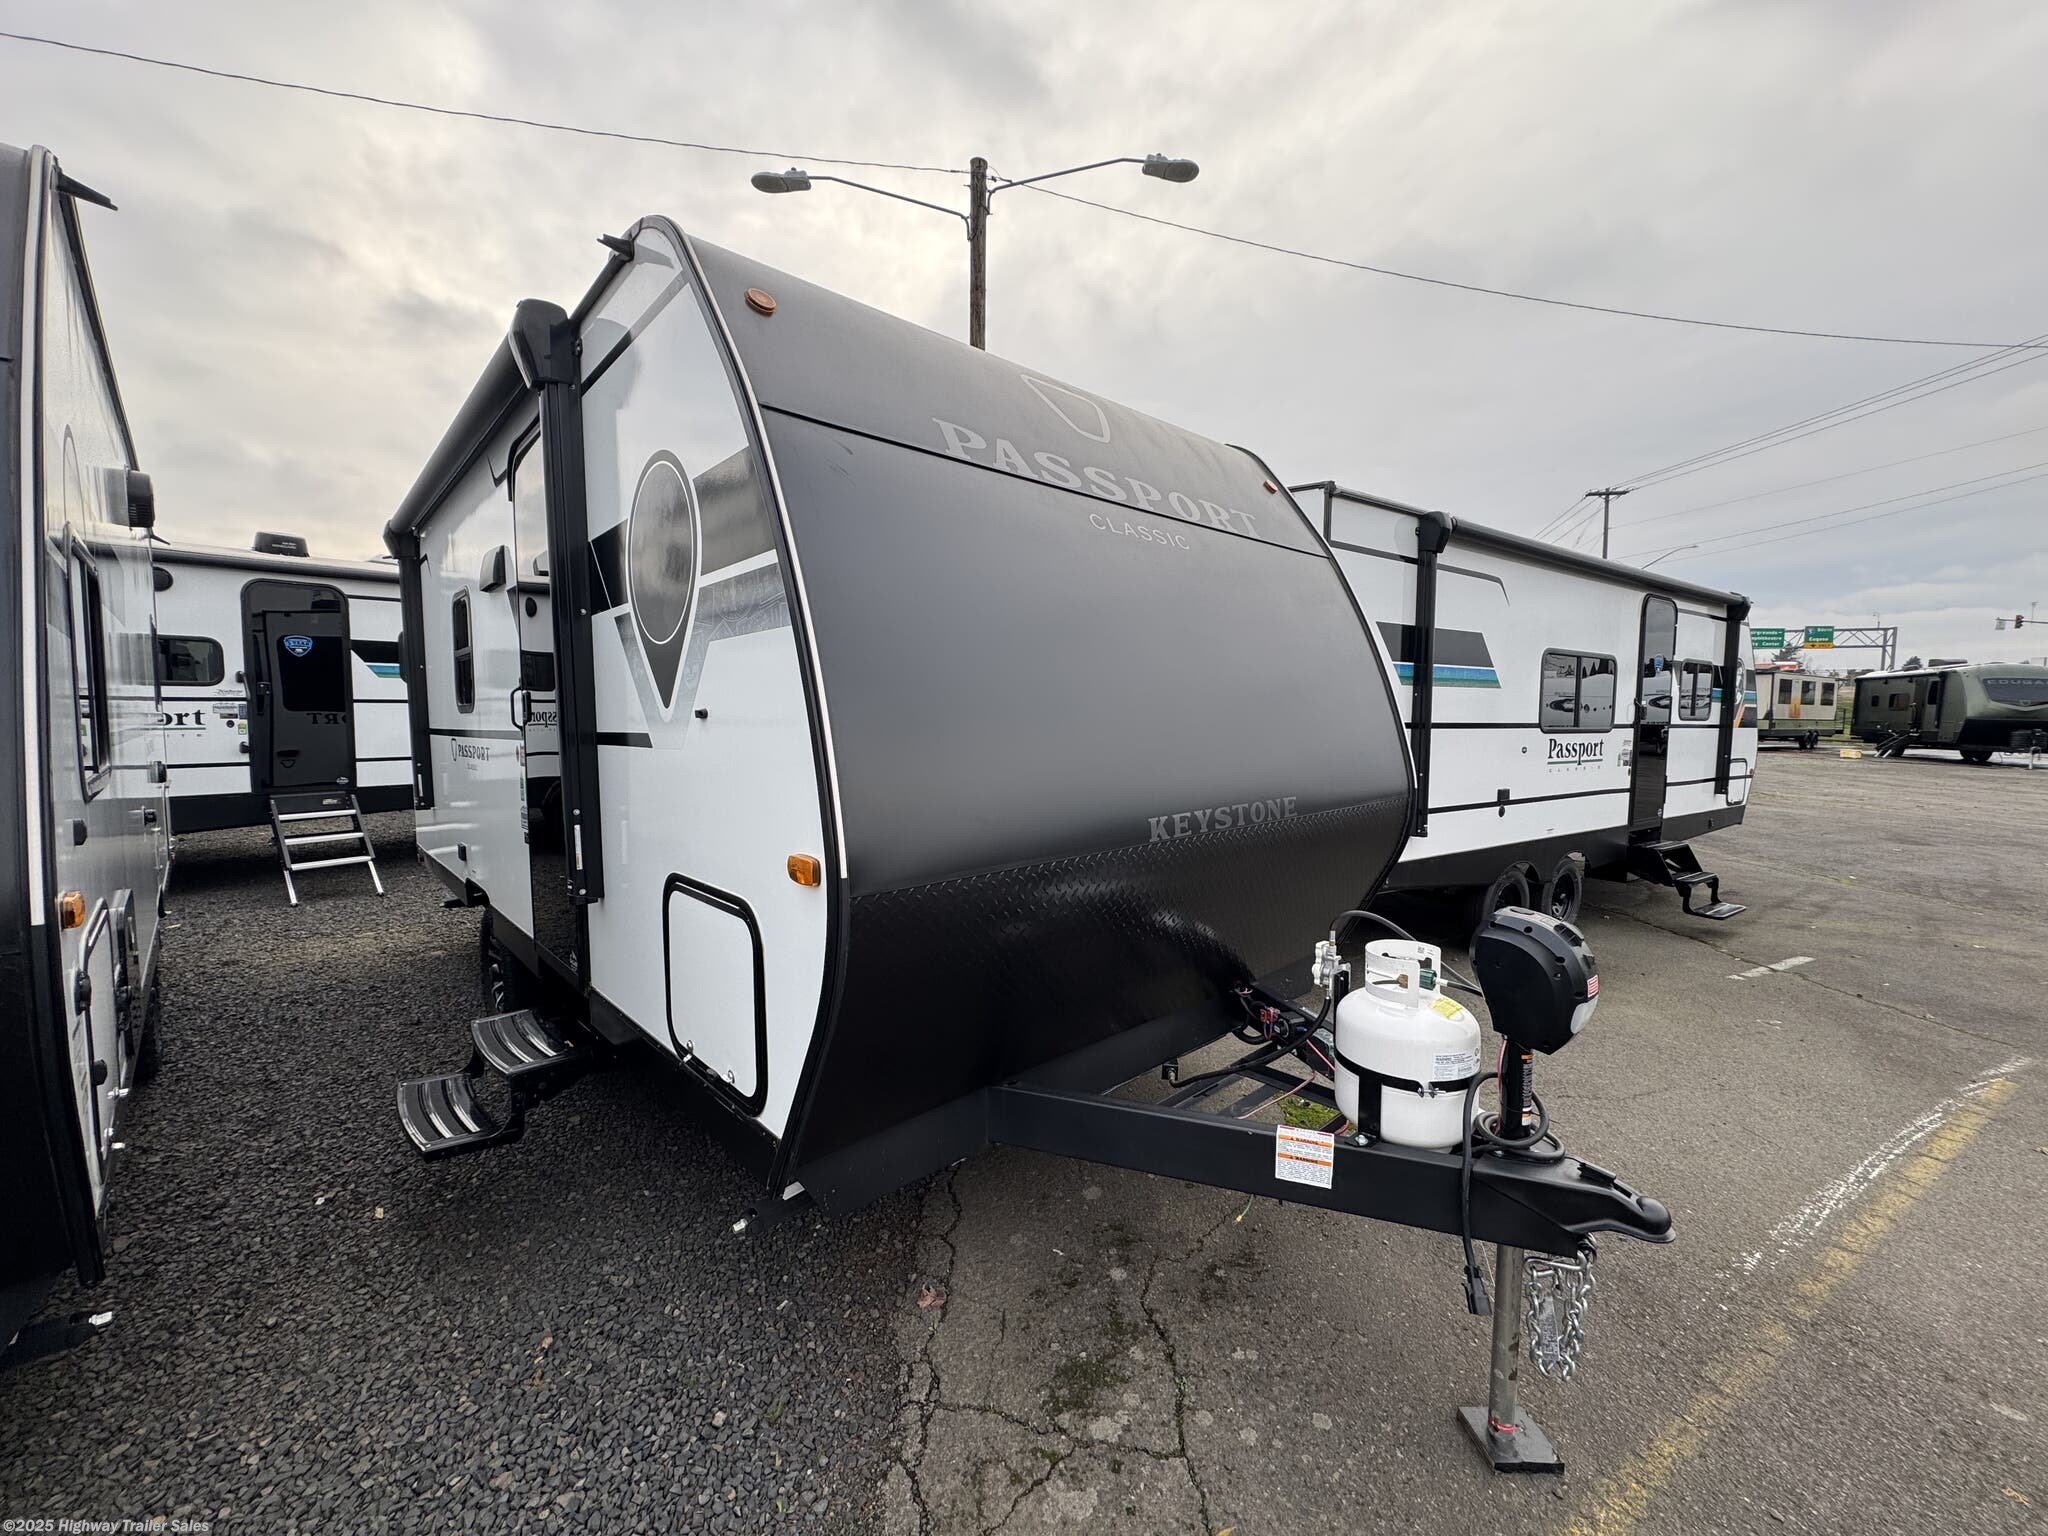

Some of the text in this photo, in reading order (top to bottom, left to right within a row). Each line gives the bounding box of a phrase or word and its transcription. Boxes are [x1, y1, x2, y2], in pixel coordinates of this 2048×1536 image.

[932, 417, 1262, 538] PASSPORT
[1089, 513, 1190, 549] CLASSIC
[458, 744, 490, 761] PASSPORT
[1547, 738, 1604, 766] Passport
[1148, 796, 1297, 842] KEYSTONE
